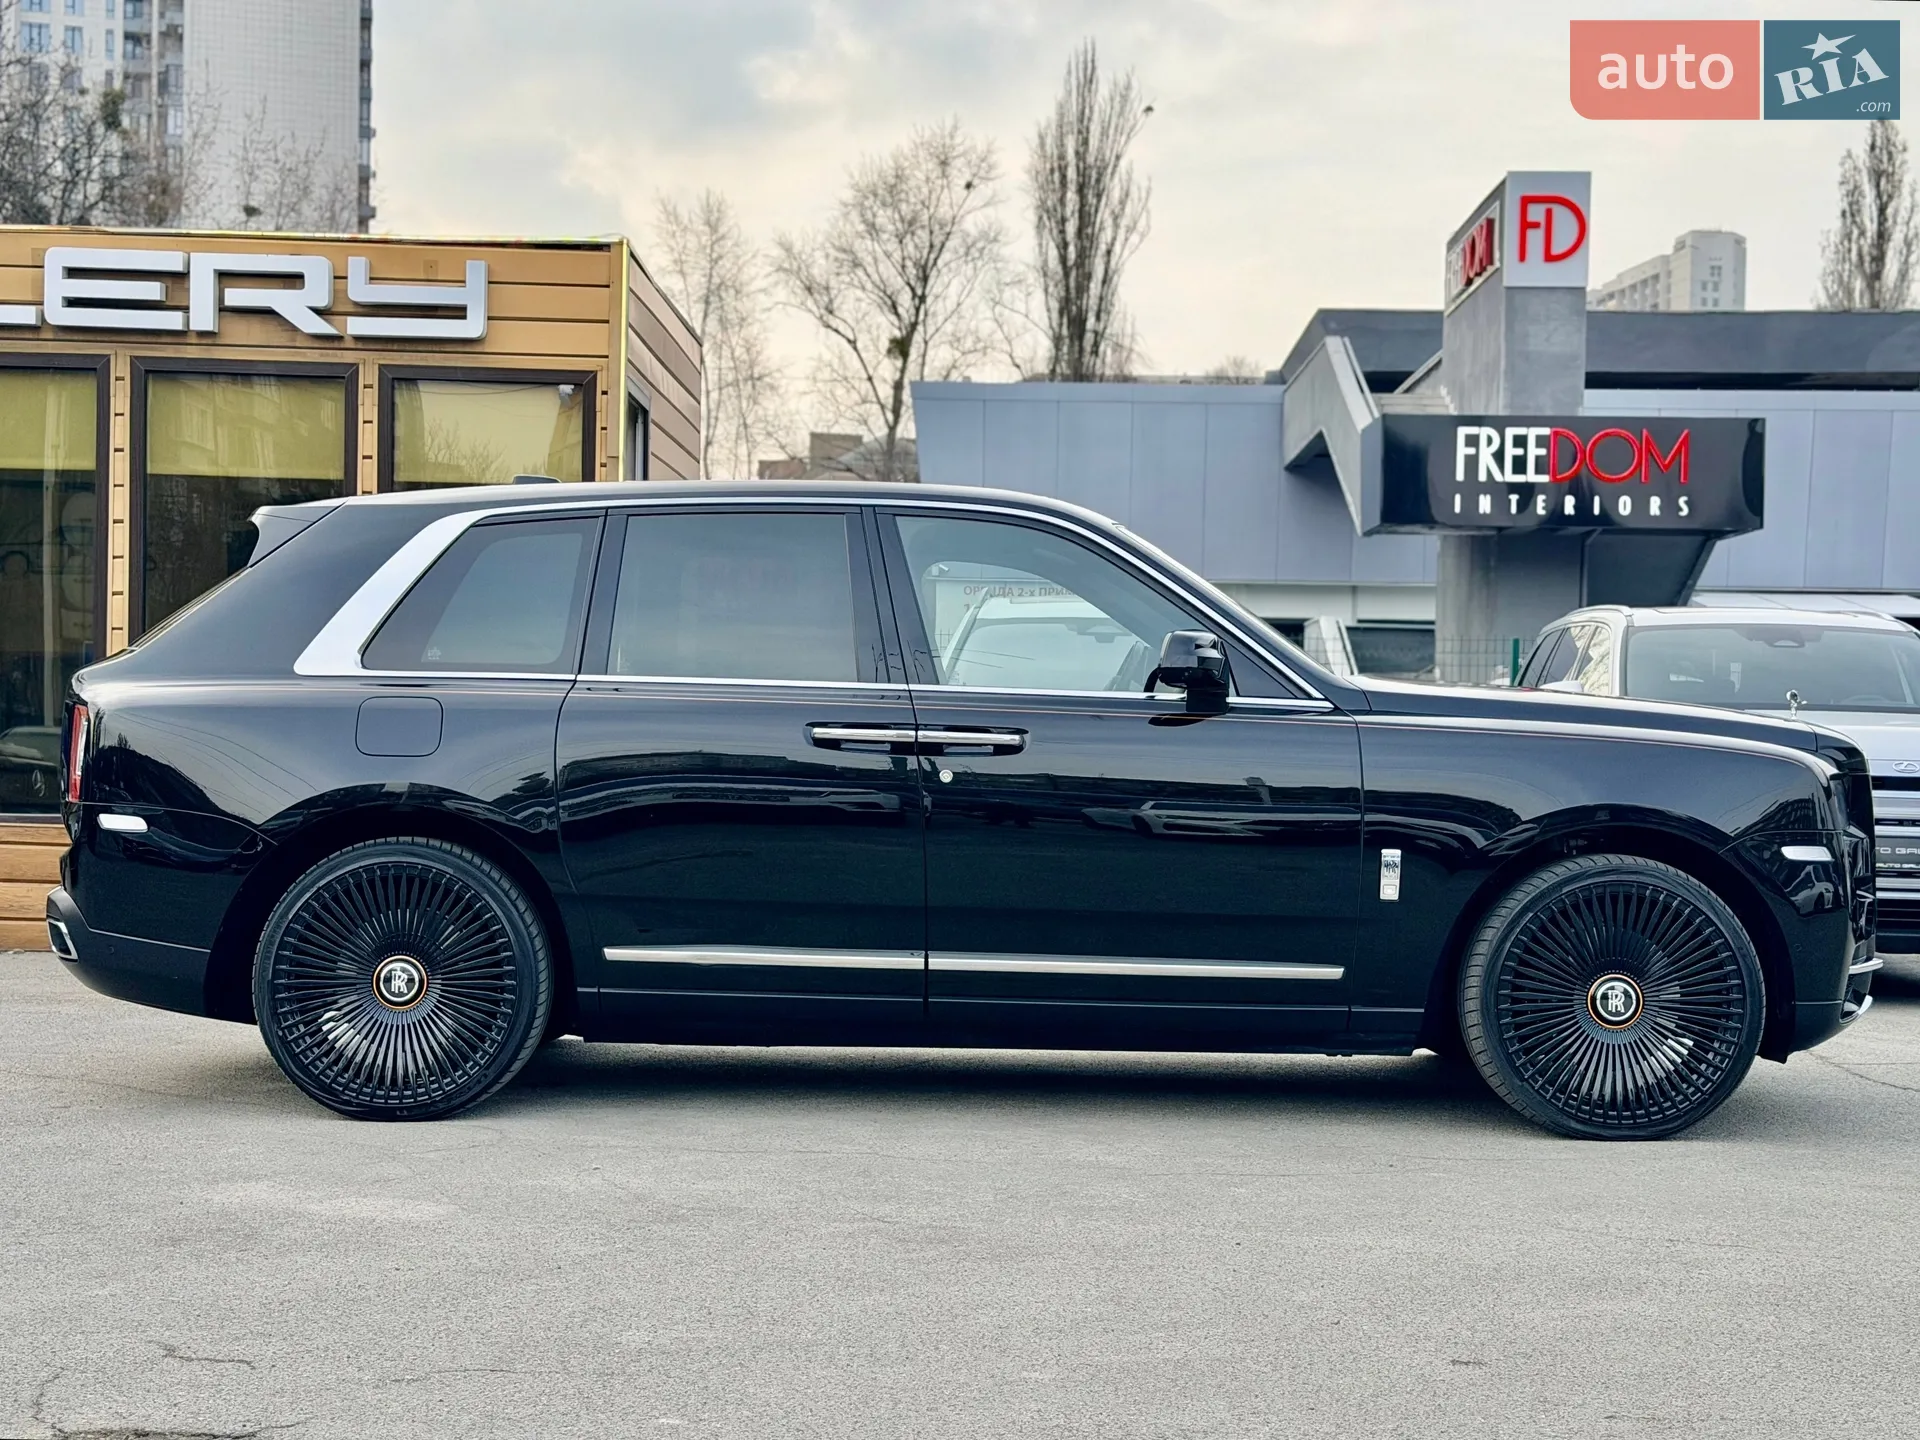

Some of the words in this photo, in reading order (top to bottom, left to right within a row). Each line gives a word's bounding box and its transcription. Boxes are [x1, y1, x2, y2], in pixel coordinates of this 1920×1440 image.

[1518, 194, 1587, 263] FD
[1455, 426, 1690, 484] FREEDOM
[1454, 493, 1690, 517] INTERIORS
[963, 585, 1014, 598] ОРДА
[1895, 847, 1920, 855] GA
